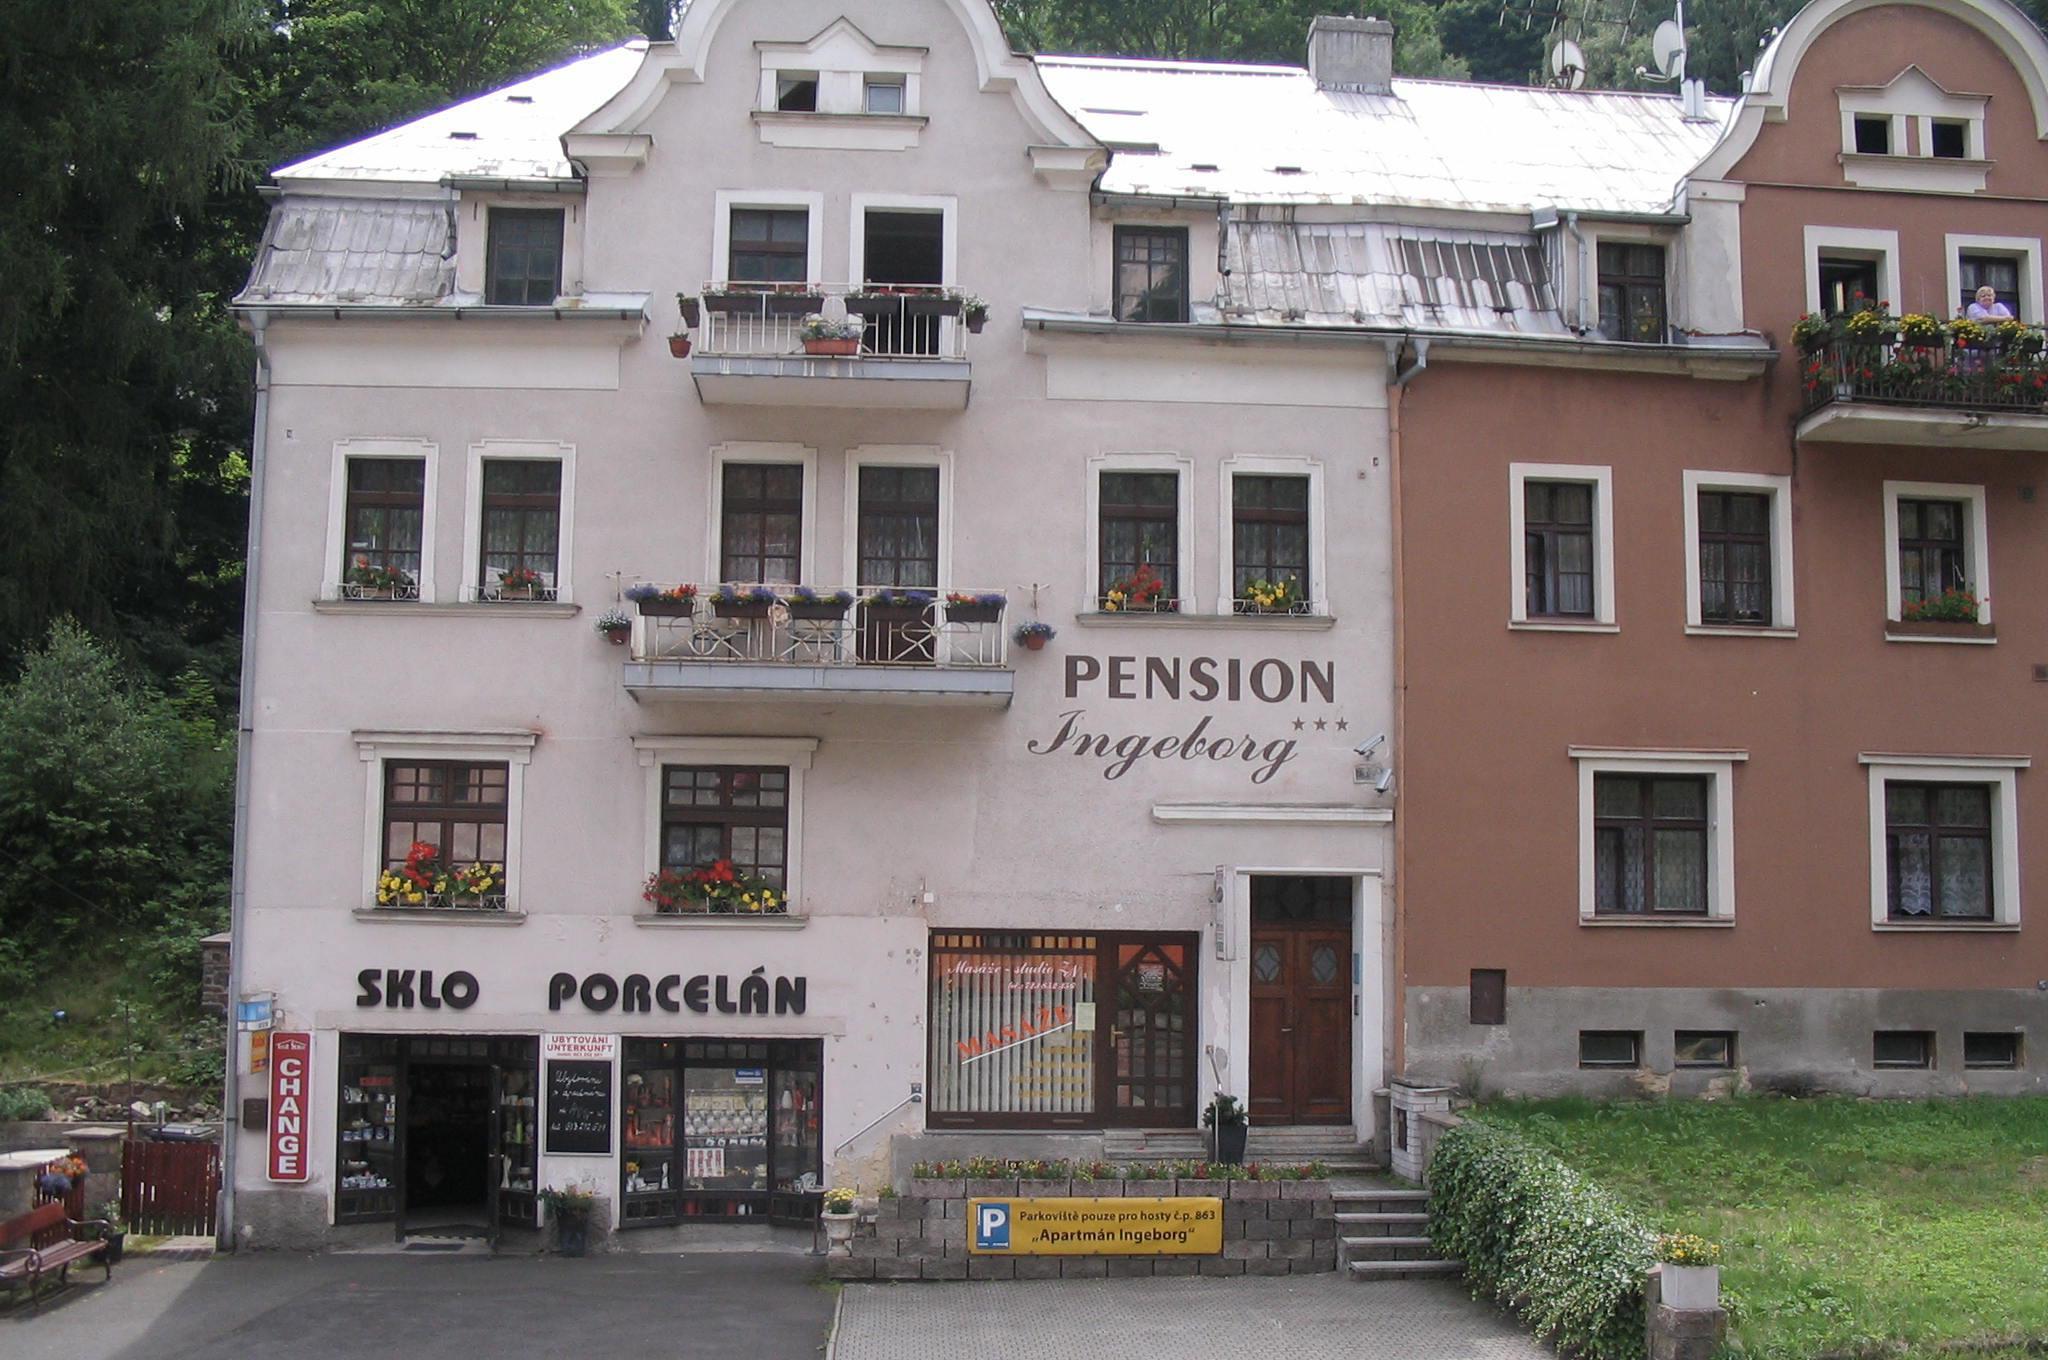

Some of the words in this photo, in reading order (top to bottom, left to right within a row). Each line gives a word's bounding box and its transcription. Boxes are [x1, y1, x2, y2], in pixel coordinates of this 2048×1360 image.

[1064, 654, 1335, 704] PENSION
[1026, 709, 1299, 785] Ingeborg
[1013, 960, 1054, 976] studio
[356, 968, 480, 1010] SKLO
[548, 965, 807, 1015] PORCELÁN
[546, 1044, 613, 1052] UNTERKUNFT
[277, 1058, 302, 1174] CHANGE
[983, 1208, 1006, 1237] P
[1019, 1210, 1079, 1221] Parkoviště
[1080, 1212, 1116, 1224] pouze
[1118, 1212, 1138, 1224] pro
[1140, 1210, 1171, 1223] hosty
[1173, 1210, 1193, 1224] č.p.
[1195, 1210, 1215, 1220] 863
[1031, 1228, 1115, 1244] „Apartmán
